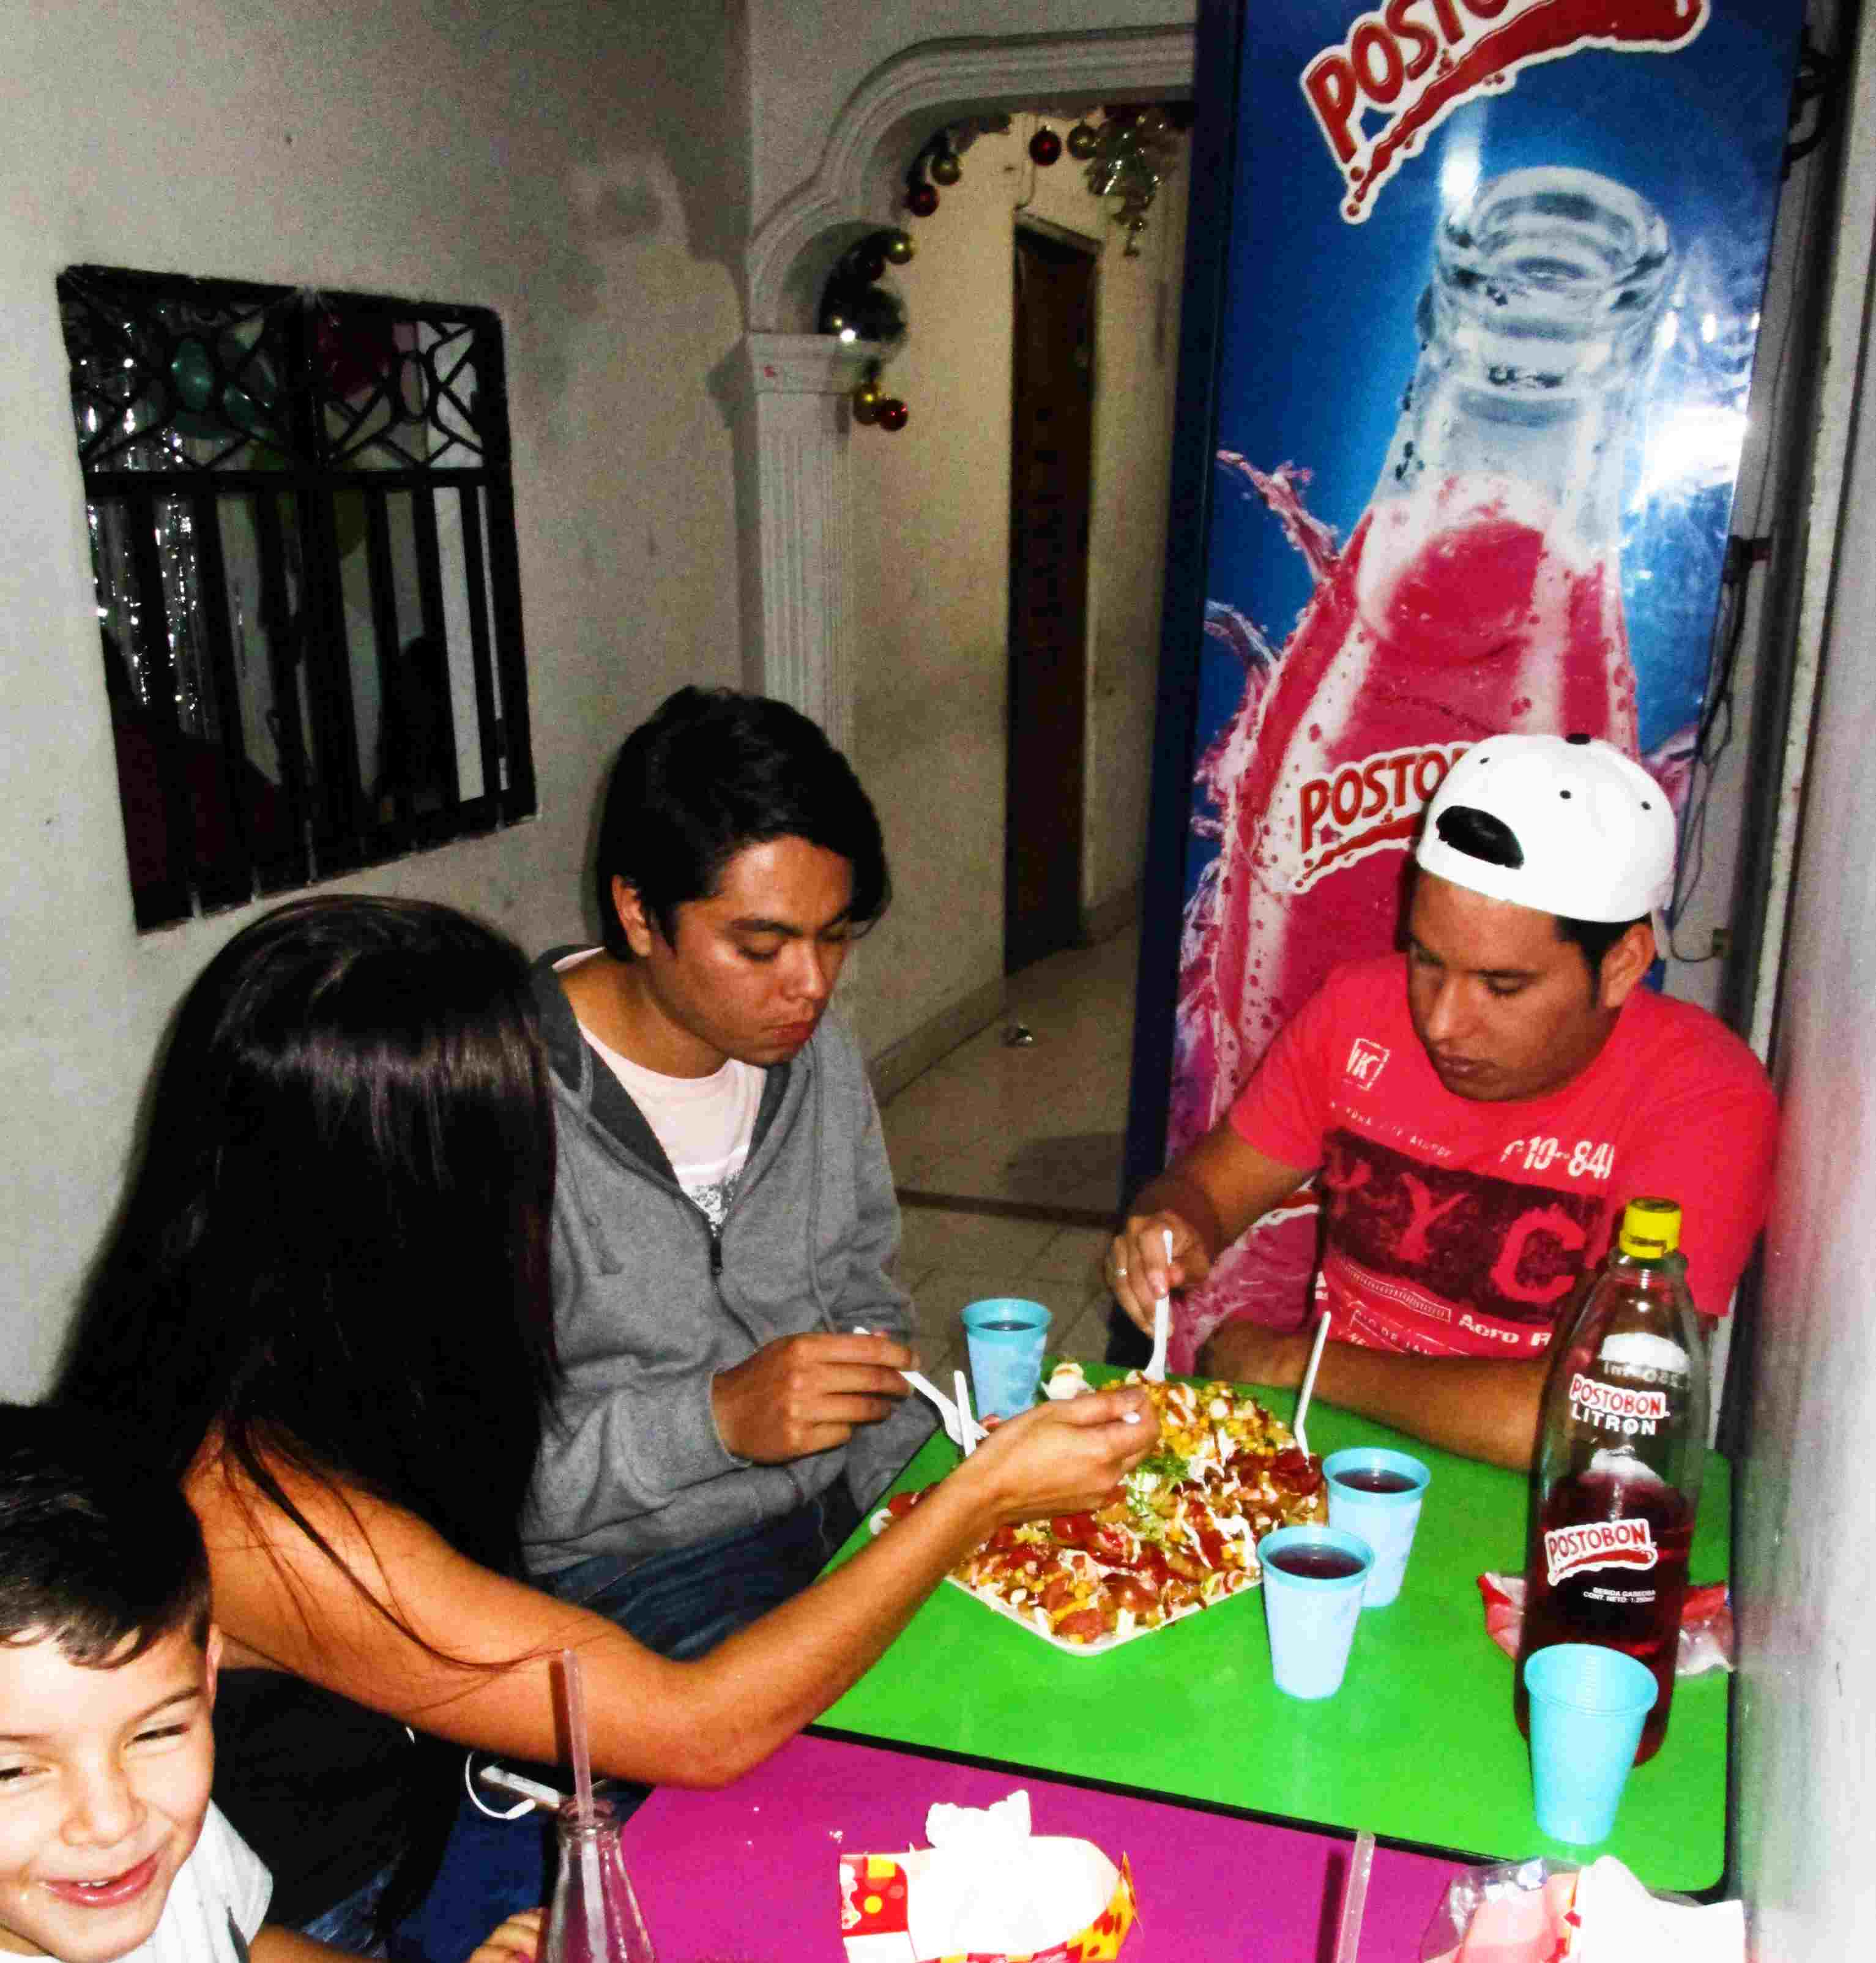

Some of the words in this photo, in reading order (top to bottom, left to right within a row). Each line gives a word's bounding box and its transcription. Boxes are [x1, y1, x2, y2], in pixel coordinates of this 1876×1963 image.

[1305, 0, 1509, 164] POST
[1300, 747, 1470, 854] POSTO
[1571, 1376, 1662, 1417] POSTOBON
[1571, 1402, 1656, 1436] LITRON
[1547, 1522, 1647, 1565] POSTOBON
